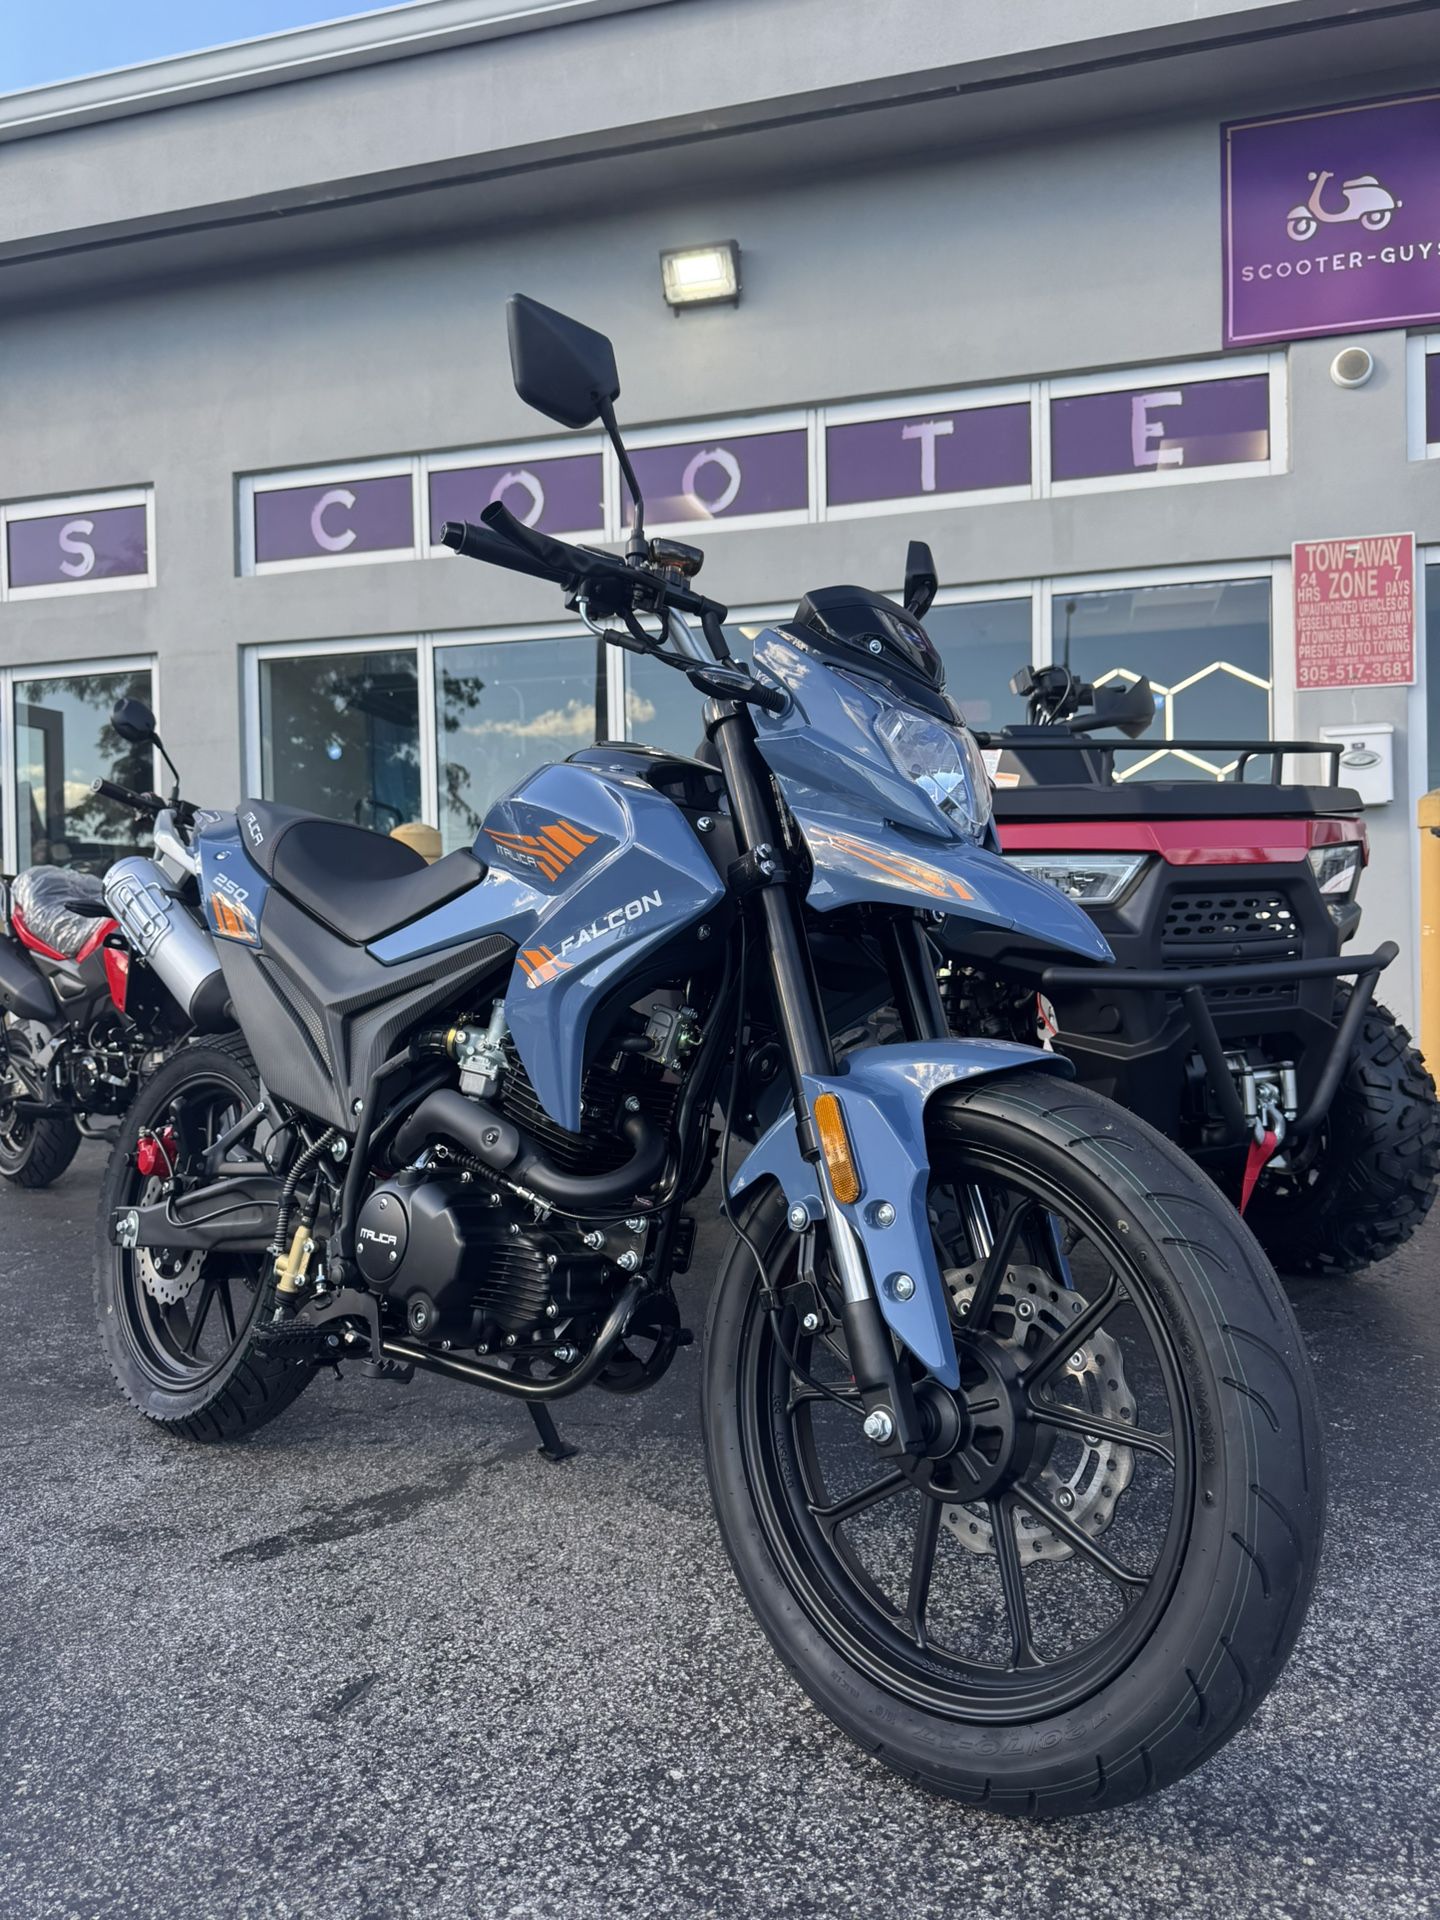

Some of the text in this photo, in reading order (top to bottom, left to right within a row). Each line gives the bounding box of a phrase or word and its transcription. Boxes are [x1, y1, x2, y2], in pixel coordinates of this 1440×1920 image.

[59, 520, 95, 577] S
[310, 489, 357, 552] C
[682, 448, 741, 514] O
[902, 421, 953, 491] T
[1132, 391, 1183, 466] E
[1305, 538, 1401, 571] TOW-AWAY
[1394, 566, 1402, 580] 7
[1298, 587, 1320, 602] HRS
[1301, 570, 1378, 599] 24 ZONE
[1385, 580, 1409, 596] DAYS
[1299, 597, 1409, 616] UNAUTHORIZED VEHICLES OR
[1297, 611, 1412, 631] VESSELS WILL BE TOWED AWAY
[1301, 632, 1311, 645] AT
[1346, 628, 1364, 642] RISK
[1373, 625, 1408, 640] EXPENSE
[1299, 639, 1410, 658] PRESTIGE AUTO TOWING
[1300, 662, 1411, 681] 305-517-3681
[212, 872, 249, 901] 250
[560, 889, 663, 957] FALCON
